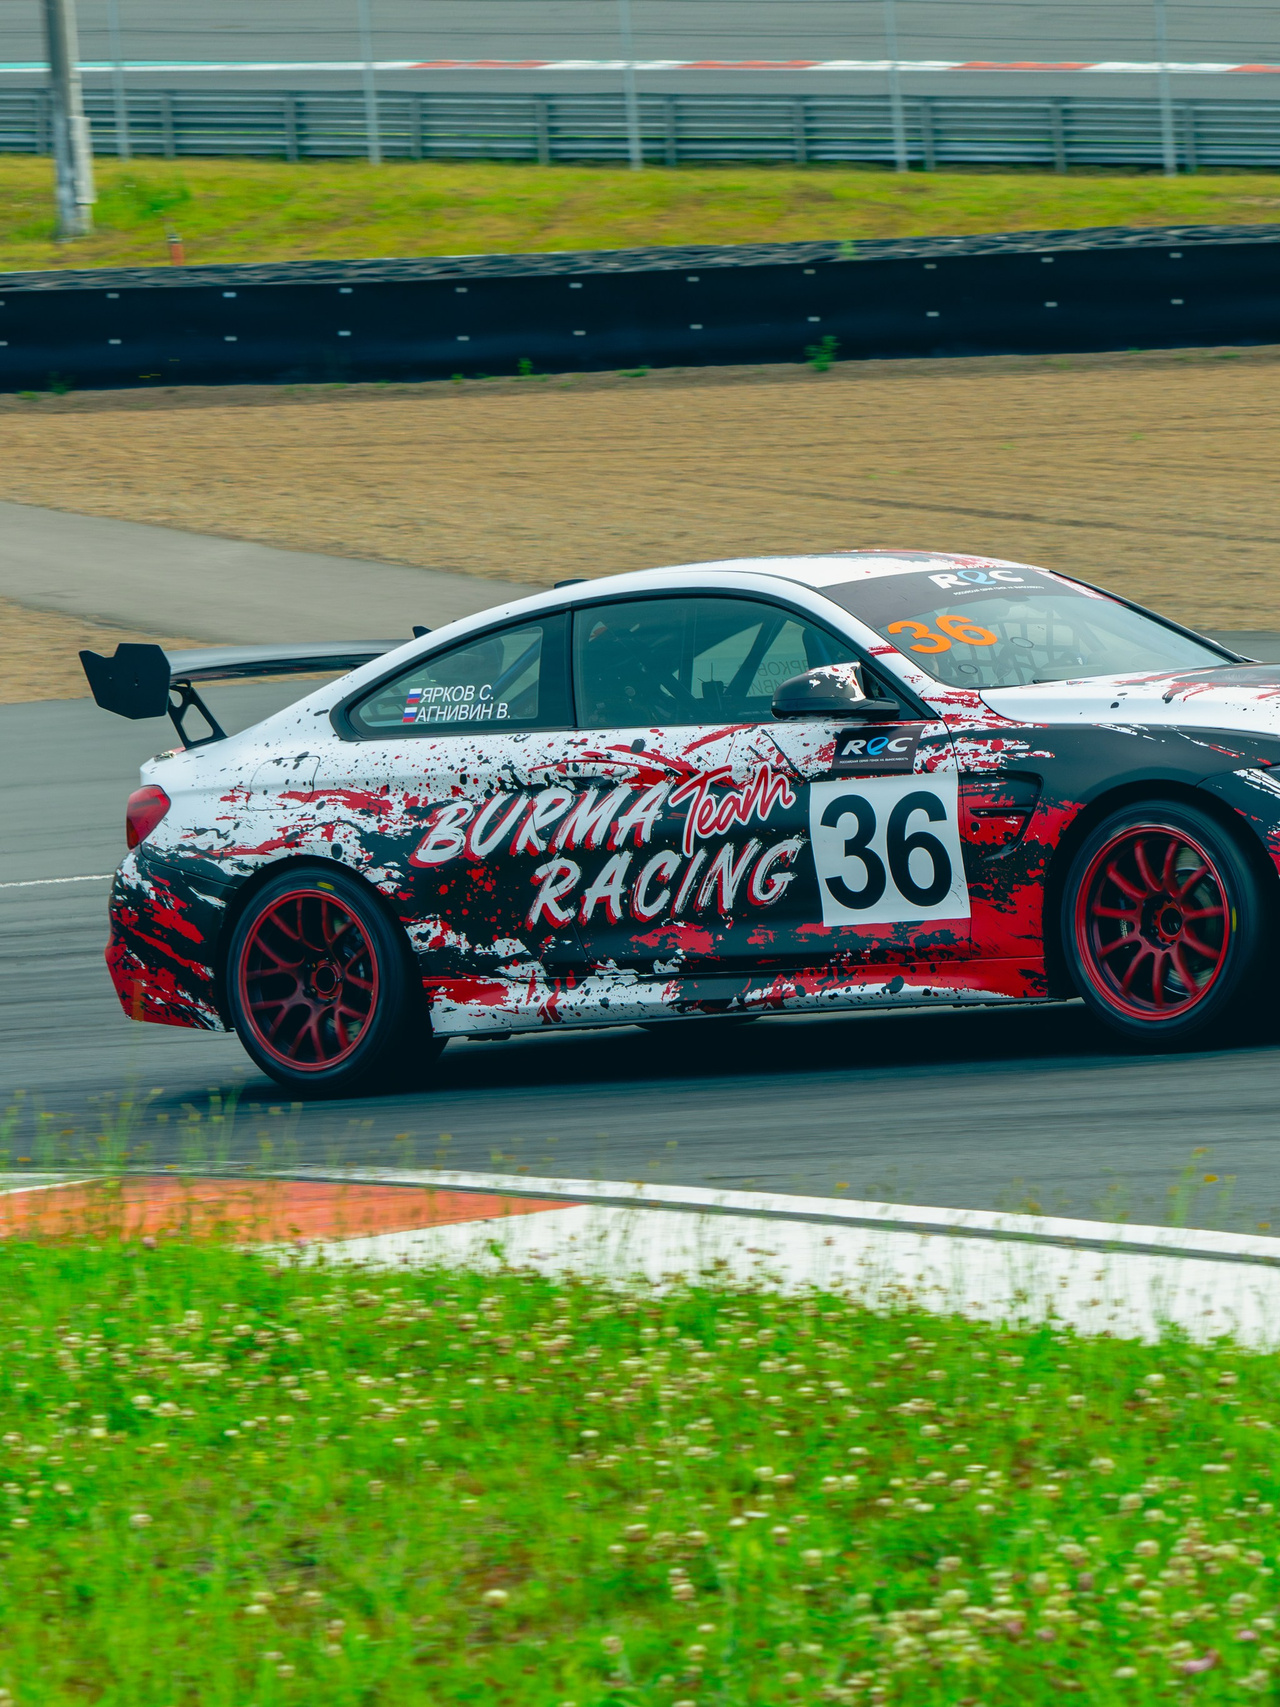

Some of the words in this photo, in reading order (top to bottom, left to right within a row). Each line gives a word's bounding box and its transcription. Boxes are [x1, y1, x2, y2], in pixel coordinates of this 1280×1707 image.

[887, 614, 997, 654] 36
[415, 703, 494, 722] АГНИВИН
[496, 702, 511, 719] В.
[420, 685, 475, 703] ЯРКОВ
[479, 684, 494, 700] С.
[410, 783, 674, 868] BURMA
[667, 763, 797, 857] Team
[527, 835, 804, 927] RACING
[818, 790, 954, 911] 36
